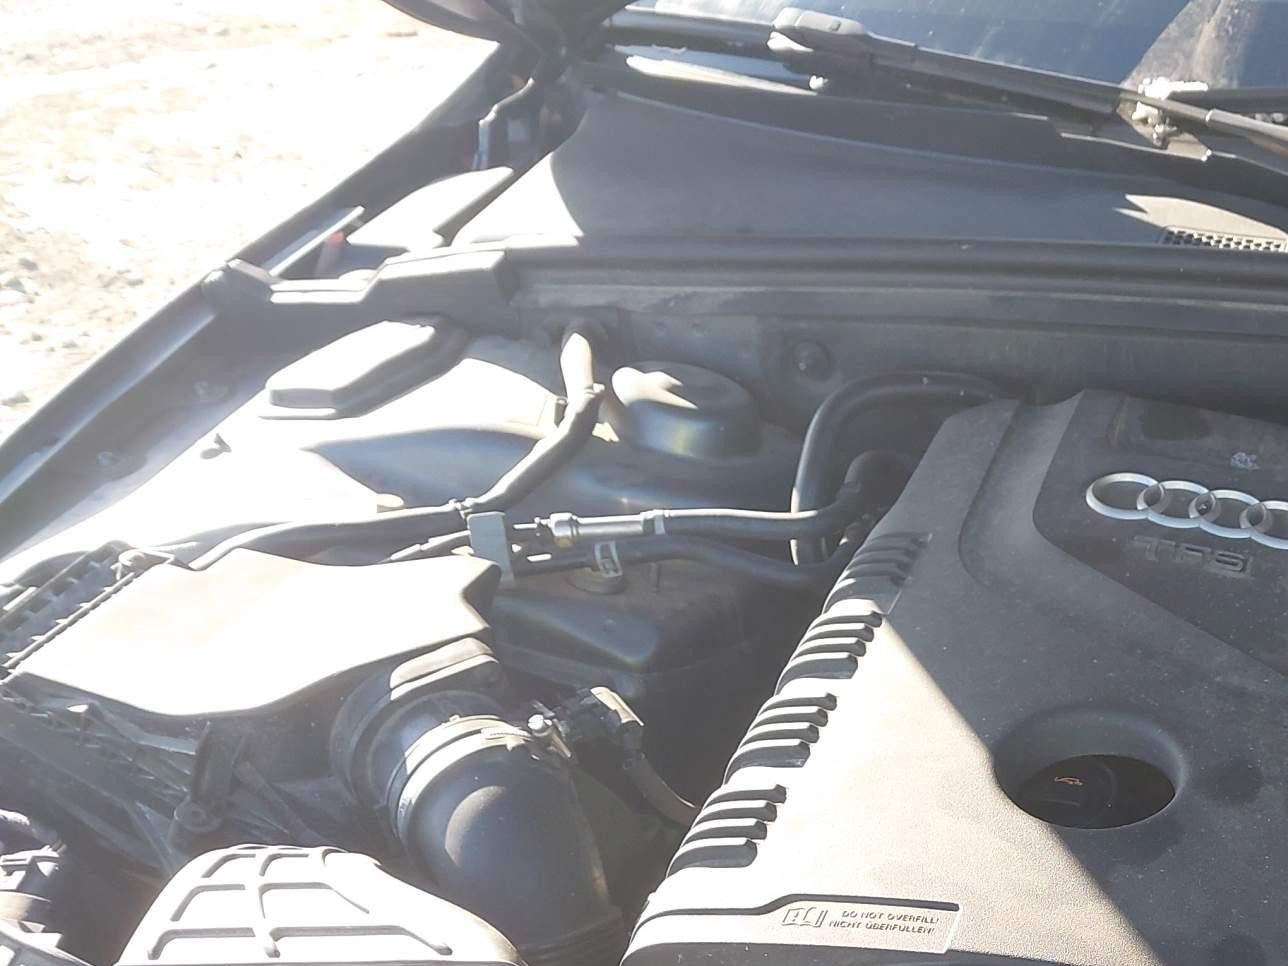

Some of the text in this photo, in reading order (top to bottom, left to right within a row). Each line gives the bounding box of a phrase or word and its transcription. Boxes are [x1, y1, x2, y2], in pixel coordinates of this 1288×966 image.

[842, 910, 939, 924] DO NOT OVERFILL!
[829, 919, 862, 929] NICHT
